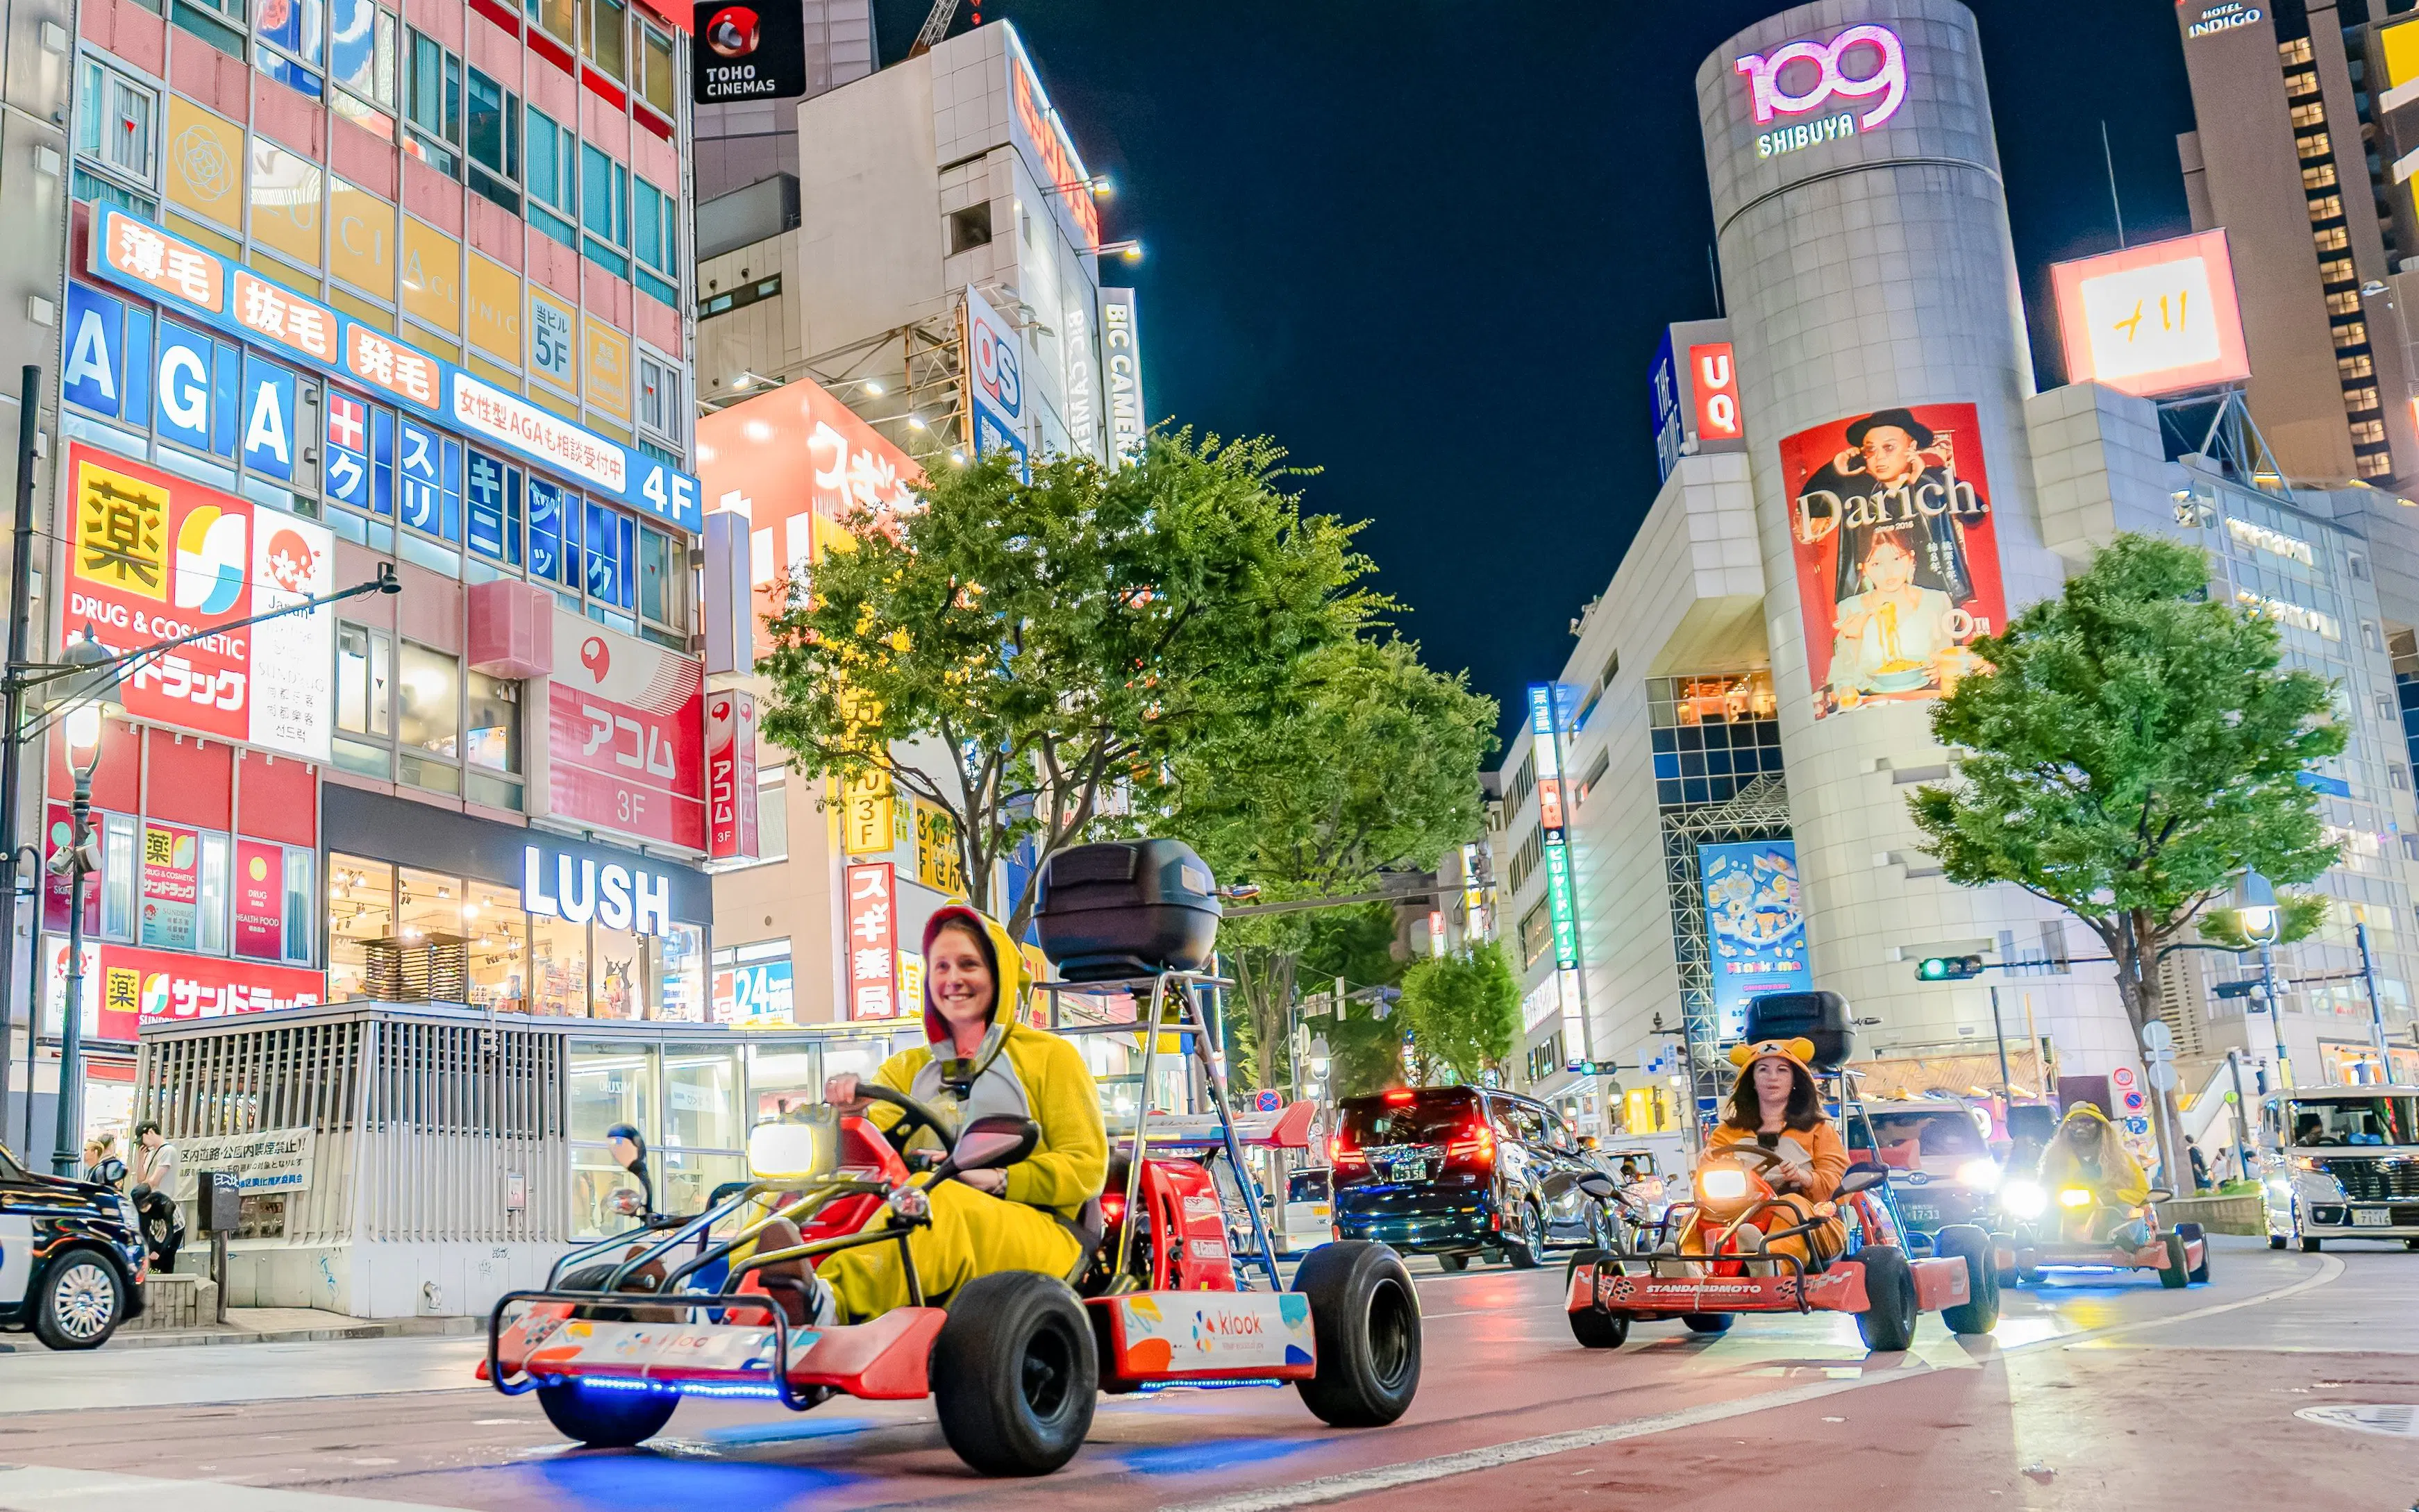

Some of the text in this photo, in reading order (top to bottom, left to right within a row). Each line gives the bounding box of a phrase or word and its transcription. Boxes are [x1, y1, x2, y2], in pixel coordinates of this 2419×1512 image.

[2188, 8, 2261, 38] INDIGO
[2202, 3, 2243, 19] HOTEL
[707, 65, 755, 82] TOHO
[707, 79, 776, 96] CINEMAS
[1734, 23, 1908, 131] 109
[1757, 112, 1855, 158] SHIBUYA
[119, 221, 211, 303] 薄毛
[244, 280, 326, 355] 抜毛
[536, 304, 567, 333] 当ビル
[1106, 304, 1130, 348] BIC
[357, 330, 430, 402] 発毛
[535, 324, 567, 371] 5F
[64, 308, 290, 464] AGA
[1654, 358, 1673, 421] THE
[1702, 355, 1736, 433] UQ
[459, 387, 622, 481] 女性型AGAも相談受付中
[642, 465, 694, 521] 4F
[1796, 466, 1990, 544] Darich.
[83, 479, 160, 589] 薬
[71, 591, 128, 628] DRUG
[133, 611, 149, 634] &
[151, 616, 246, 661] COSMETIC
[582, 703, 676, 780] アコム
[617, 789, 646, 825] 3F
[713, 759, 733, 825] アコム
[147, 832, 169, 863] 薬
[717, 830, 732, 843] 3F
[167, 871, 195, 882] COSMETIC
[249, 889, 267, 900] DRUG
[525, 845, 669, 938] LUSH
[236, 914, 278, 926] HEALTH FOOD
[853, 870, 892, 1018] スギ薬局
[110, 973, 135, 1007] 薬
[736, 967, 767, 1014] 24
[1218, 1310, 1262, 1335] klook
